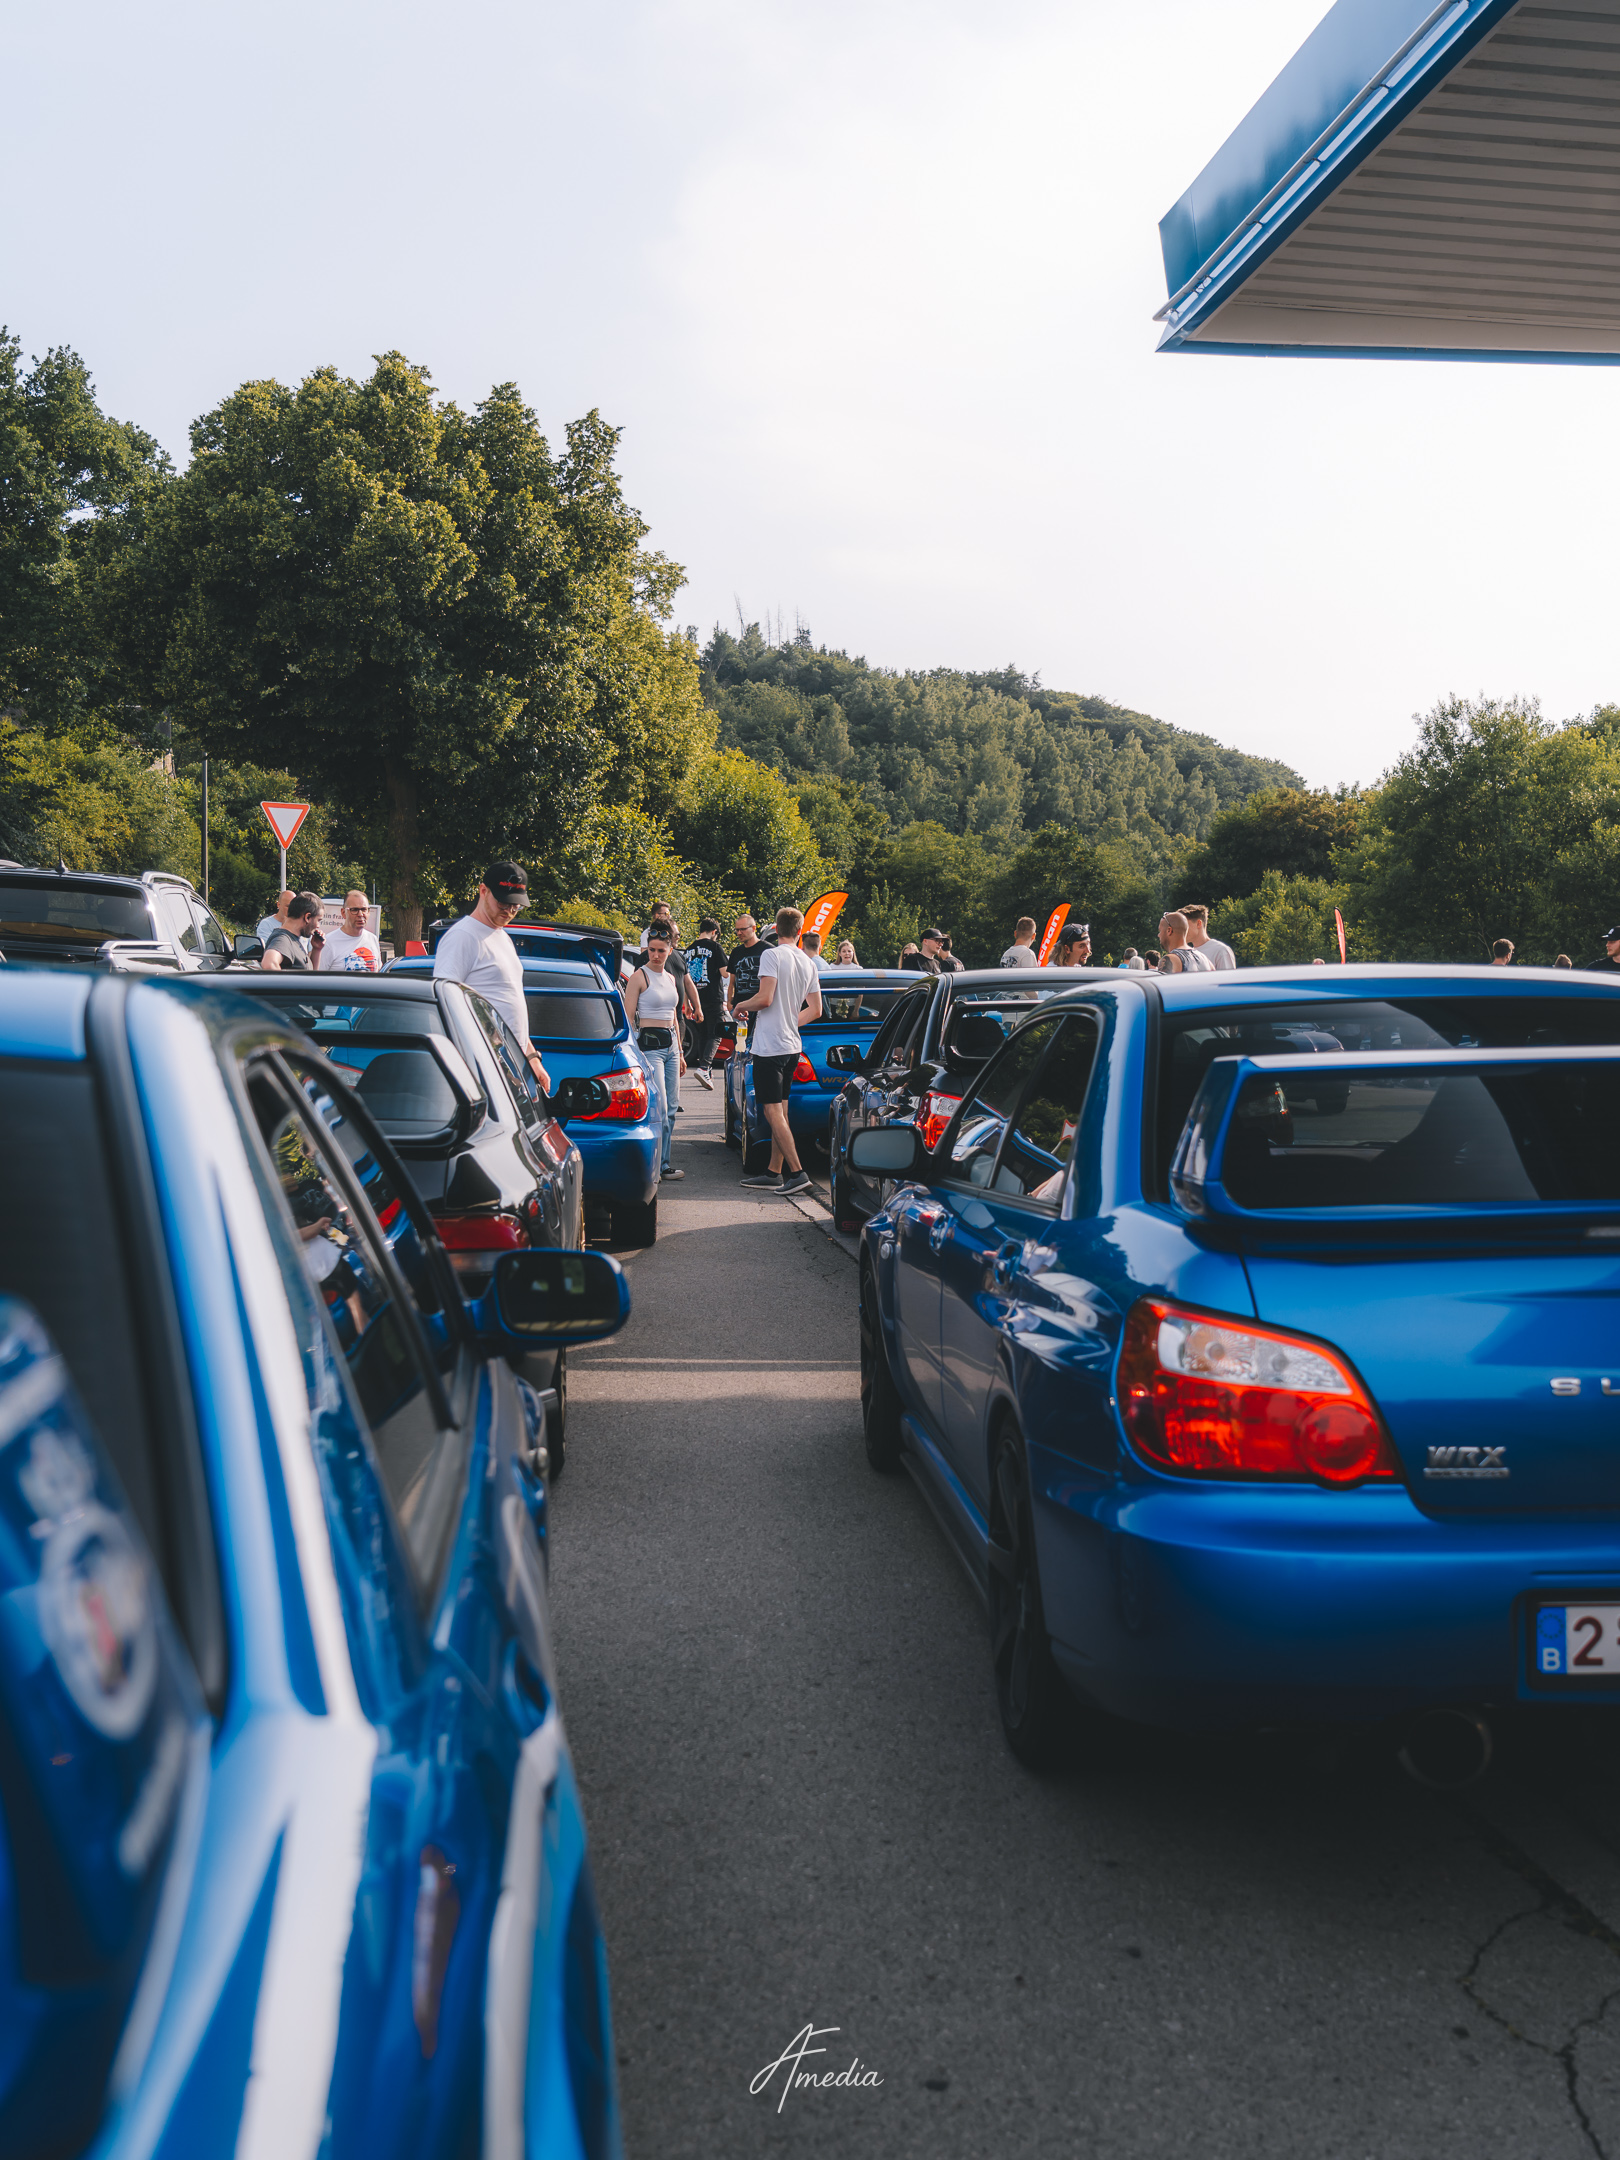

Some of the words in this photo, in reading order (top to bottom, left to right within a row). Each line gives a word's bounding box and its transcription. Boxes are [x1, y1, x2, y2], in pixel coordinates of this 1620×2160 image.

[1427, 1446, 1506, 1467] WRX
[1542, 1647, 1561, 1671] B
[1573, 1614, 1620, 1667] 2
